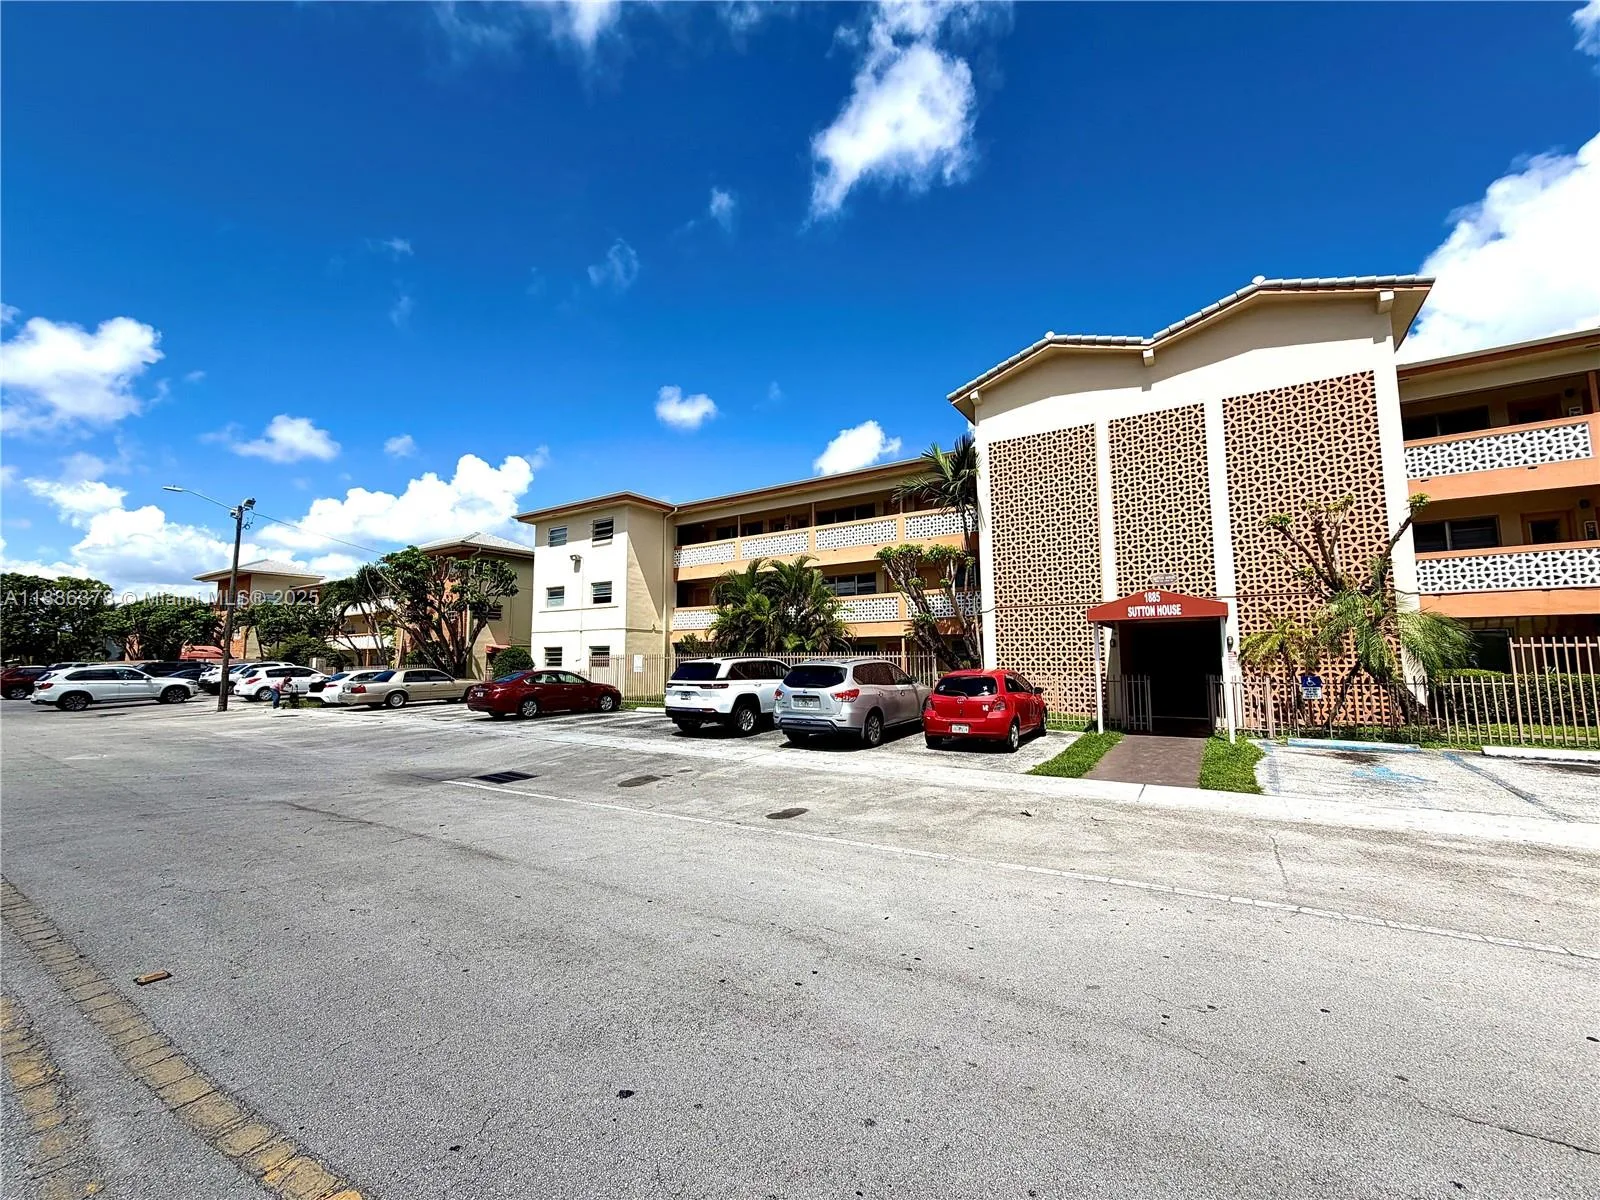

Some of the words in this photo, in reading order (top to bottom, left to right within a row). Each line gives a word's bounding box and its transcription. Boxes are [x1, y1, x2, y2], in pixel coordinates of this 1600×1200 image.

[1144, 591, 1160, 602] 1885
[1127, 605, 1156, 617] SUTTON
[1156, 603, 1182, 616] HOUSE
